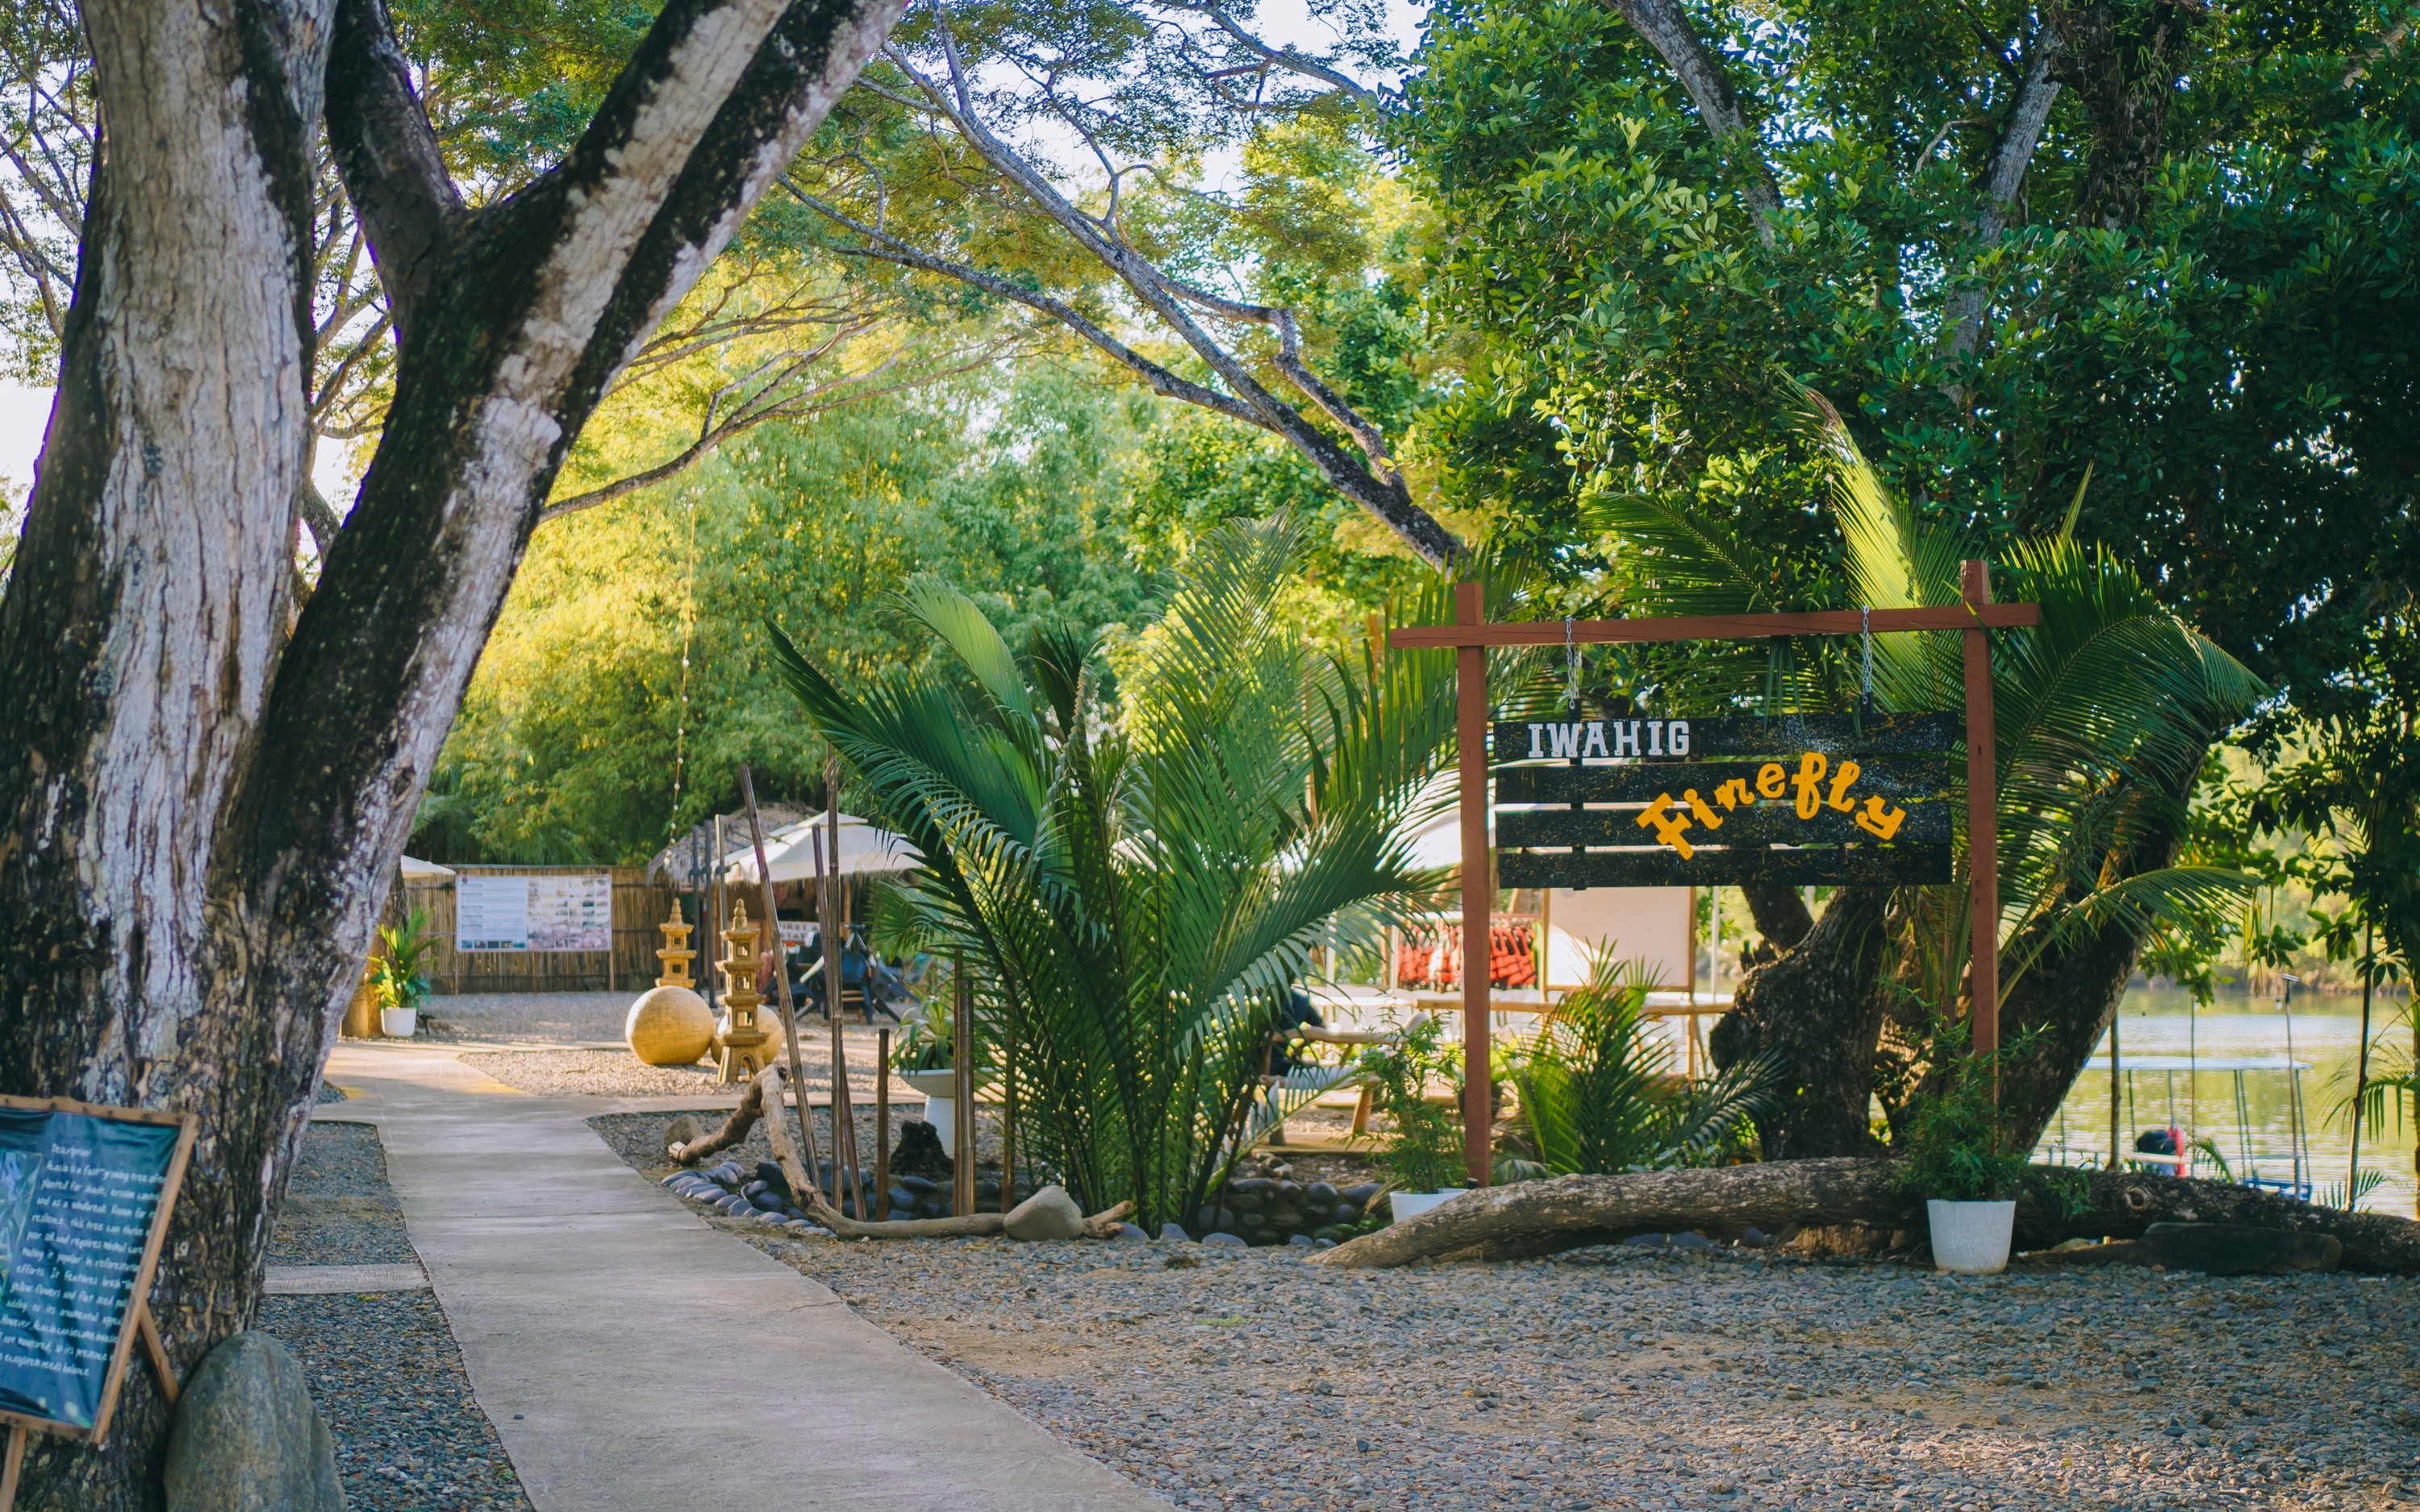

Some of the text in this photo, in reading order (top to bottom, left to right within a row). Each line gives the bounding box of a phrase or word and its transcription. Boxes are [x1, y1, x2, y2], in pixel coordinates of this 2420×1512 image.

[1528, 720, 1690, 758] IWAHIG
[1636, 751, 1907, 860] Firefly
[131, 1173, 148, 1181] tree
[71, 1181, 83, 1191] for
[37, 1196, 52, 1205] and
[52, 1198, 61, 1206] as
[136, 1207, 148, 1218] for
[71, 1218, 85, 1227] this
[87, 1222, 104, 1231] tree
[123, 1226, 144, 1235] thrive
[27, 1232, 43, 1240] poor
[56, 1235, 71, 1243] and
[72, 1239, 102, 1248] requires
[48, 1251, 55, 1259] it
[57, 1254, 83, 1264] popular
[86, 1257, 93, 1265] in
[52, 1268, 60, 1277] It
[65, 1270, 98, 1284] features
[10, 1281, 33, 1292] yellow
[35, 1285, 61, 1297] flowers
[64, 1290, 77, 1298] and
[79, 1291, 94, 1302] flat
[97, 1296, 115, 1305] seed
[6, 1300, 28, 1312] adding
[33, 1303, 42, 1311] to
[46, 1305, 56, 1314] its
[60, 1310, 99, 1322] ornamental
[76, 1349, 108, 1360] presence
